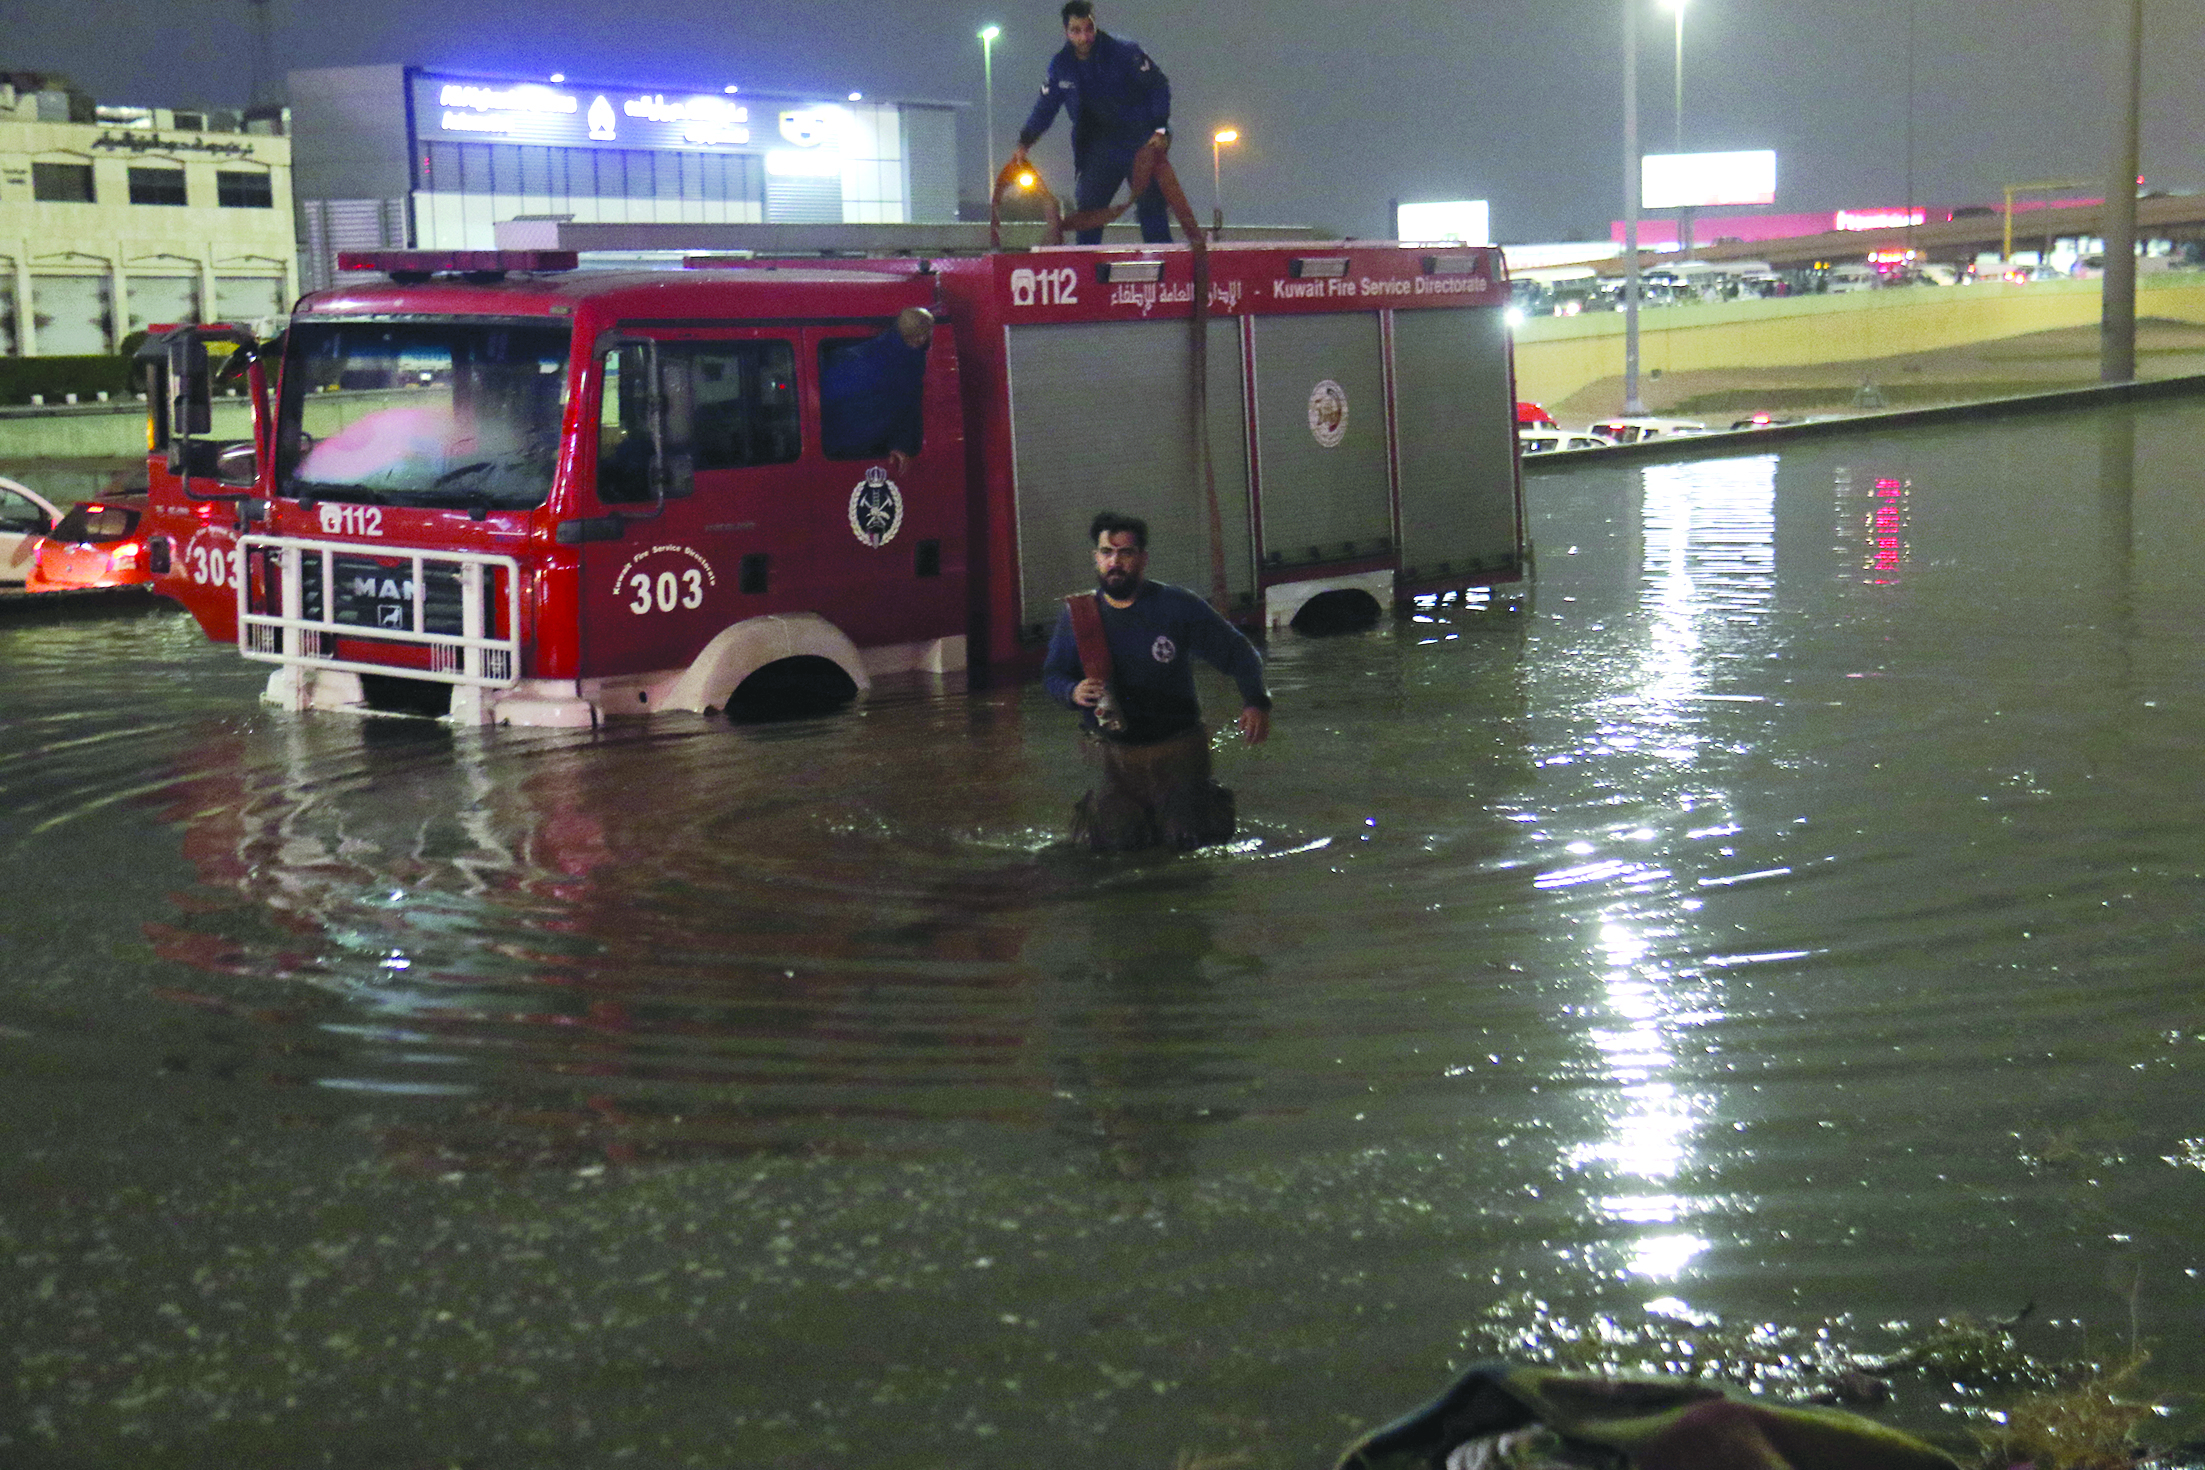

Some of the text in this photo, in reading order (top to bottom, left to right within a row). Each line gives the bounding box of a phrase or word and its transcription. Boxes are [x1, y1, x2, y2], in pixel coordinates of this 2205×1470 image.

[1036, 267, 1078, 305] 112
[1273, 275, 1488, 299] Kuwait Fire Service Directorate
[343, 506, 383, 536] 112
[612, 544, 716, 595] Kuwait Fire Service Directorate
[353, 576, 427, 601] MAN
[629, 568, 704, 615] 303
